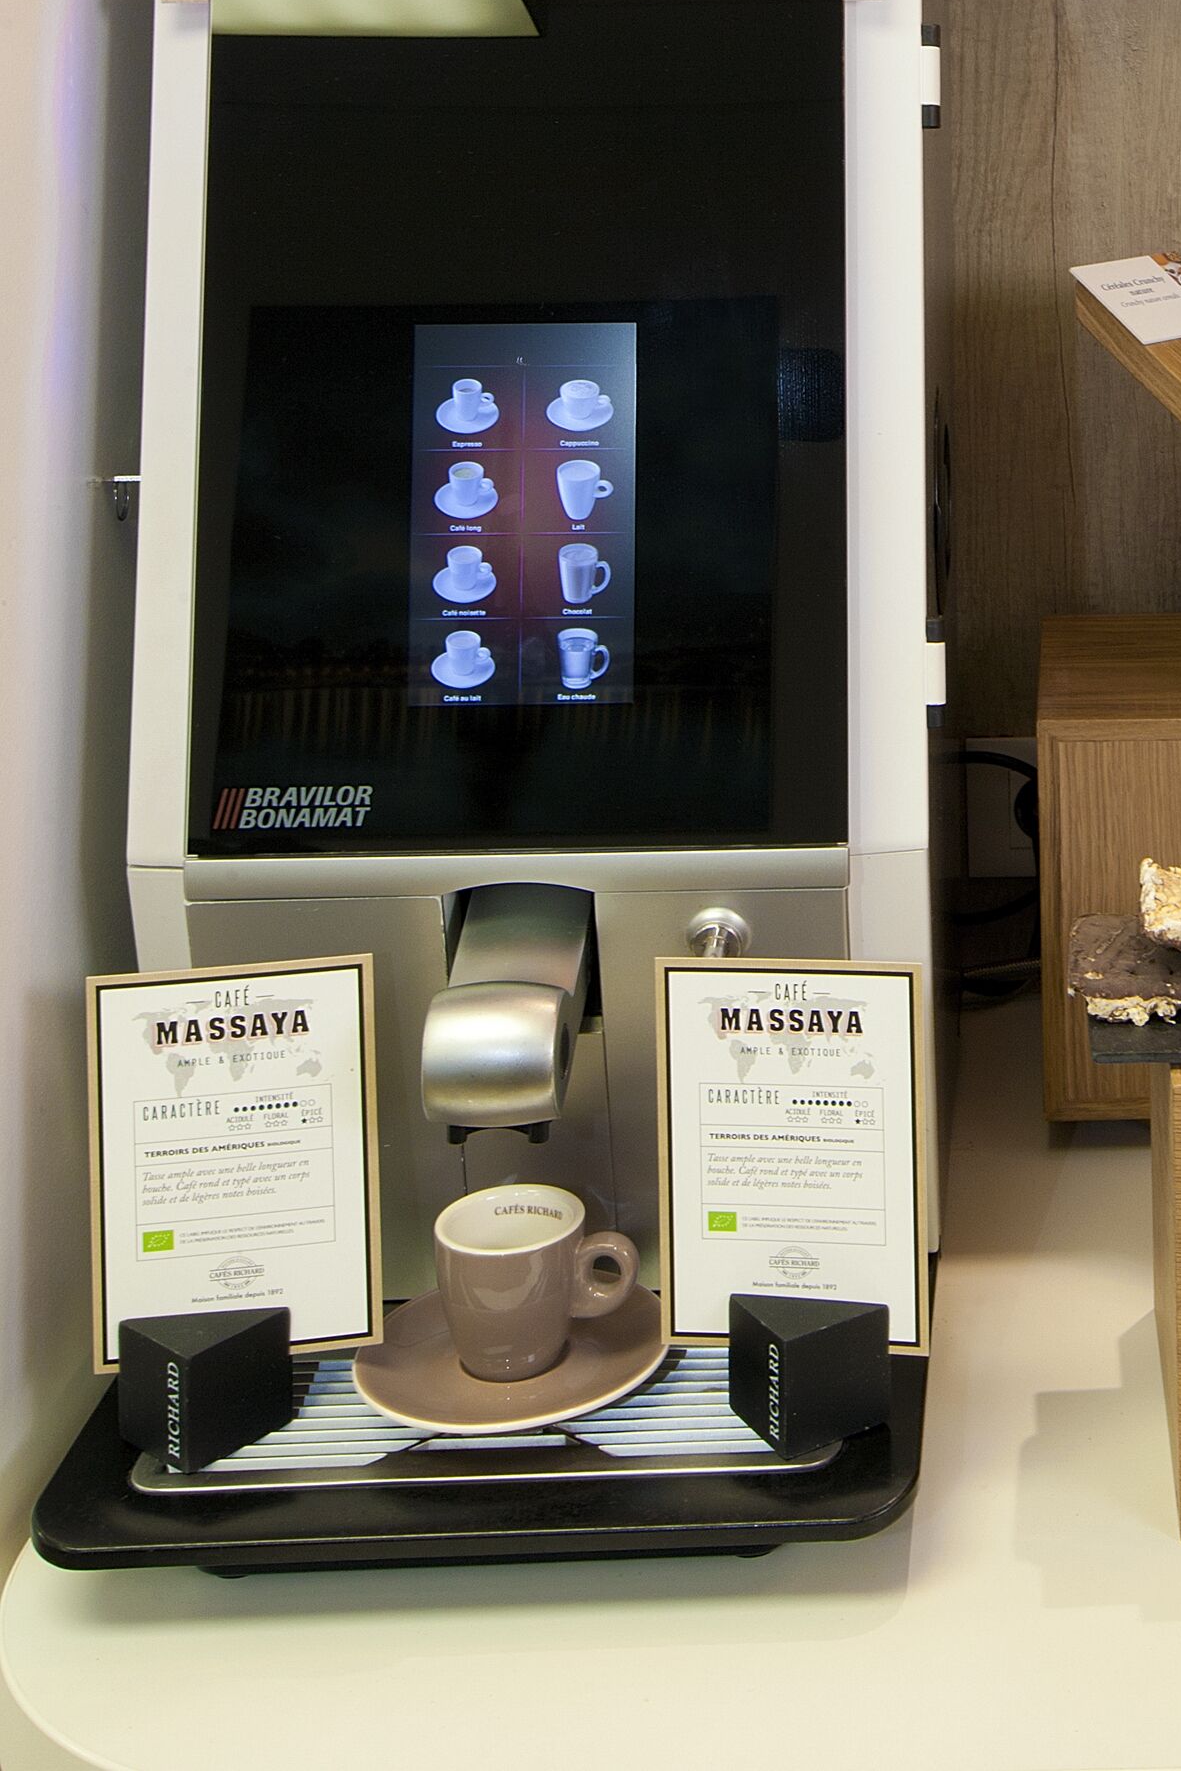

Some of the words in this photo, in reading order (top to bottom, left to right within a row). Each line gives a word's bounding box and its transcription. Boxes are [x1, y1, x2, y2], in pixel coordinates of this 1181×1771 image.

[1101, 281, 1133, 291] Céréales
[1134, 276, 1165, 286] Crunchy
[560, 440, 600, 448] Cappuccino
[450, 524, 465, 532] Café
[442, 609, 458, 617] Café
[562, 608, 593, 616] Chocolat
[444, 694, 460, 702] Café
[469, 694, 482, 702] lait
[557, 693, 570, 701] Eau
[571, 693, 596, 701] chaude
[244, 785, 373, 808] BRAVILOR
[239, 807, 371, 829] BONAMAT
[215, 985, 250, 1009] CAFÉ
[774, 980, 808, 1002] CAFÉ
[156, 1009, 310, 1046] MASSAYA
[720, 1008, 863, 1034] MASSAYA
[177, 1056, 212, 1068] AMPLE
[233, 1049, 286, 1063] EXOTIQUE
[740, 1046, 772, 1056] AMPLE
[791, 1046, 841, 1058] EXOTIQUE
[255, 1091, 293, 1103] INTENSITÉ
[708, 1087, 780, 1105] CARACTÈRE
[812, 1090, 848, 1099] INTENSITÉ
[143, 1099, 220, 1121] CARACTÈRE
[263, 1112, 288, 1120] FLORAL
[819, 1109, 843, 1117] FLORAL
[771, 1134, 821, 1143] AMÉRIQUES
[144, 1148, 190, 1158] TERROIRS
[192, 1146, 209, 1154] DES
[211, 1141, 265, 1152] AMÉRIQUES
[708, 1153, 729, 1162] Tasse
[730, 1154, 756, 1166] ample
[794, 1155, 813, 1164] belle
[815, 1156, 850, 1168] longueur
[142, 1171, 166, 1181] Tasse
[167, 1168, 195, 1180] ample
[196, 1169, 216, 1177] avec
[218, 1166, 234, 1174] une
[236, 1162, 257, 1173] belle
[258, 1160, 296, 1172] longueur
[738, 1165, 758, 1177] Café
[759, 1167, 779, 1176] rond
[790, 1168, 808, 1179] typé
[842, 1171, 863, 1182] corps
[176, 1179, 198, 1193] Café
[199, 1179, 220, 1189] rond
[222, 1178, 230, 1186] et
[232, 1176, 250, 1188] typé
[252, 1175, 273, 1183] avec
[288, 1171, 310, 1182] corps
[741, 1178, 751, 1187] de
[169, 1195, 178, 1204] et
[180, 1193, 189, 1203] de
[222, 1190, 244, 1199] notes
[494, 1204, 525, 1216] CAFÉS
[527, 1205, 563, 1221] RICHARD
[209, 1270, 232, 1279] CAFÉS
[233, 1267, 264, 1277] RICHARD
[822, 1283, 837, 1291] 1892
[216, 1293, 243, 1301] familiale
[244, 1291, 265, 1300] depuis
[768, 1343, 780, 1441] RICHARD
[167, 1361, 181, 1459] RICHARD
